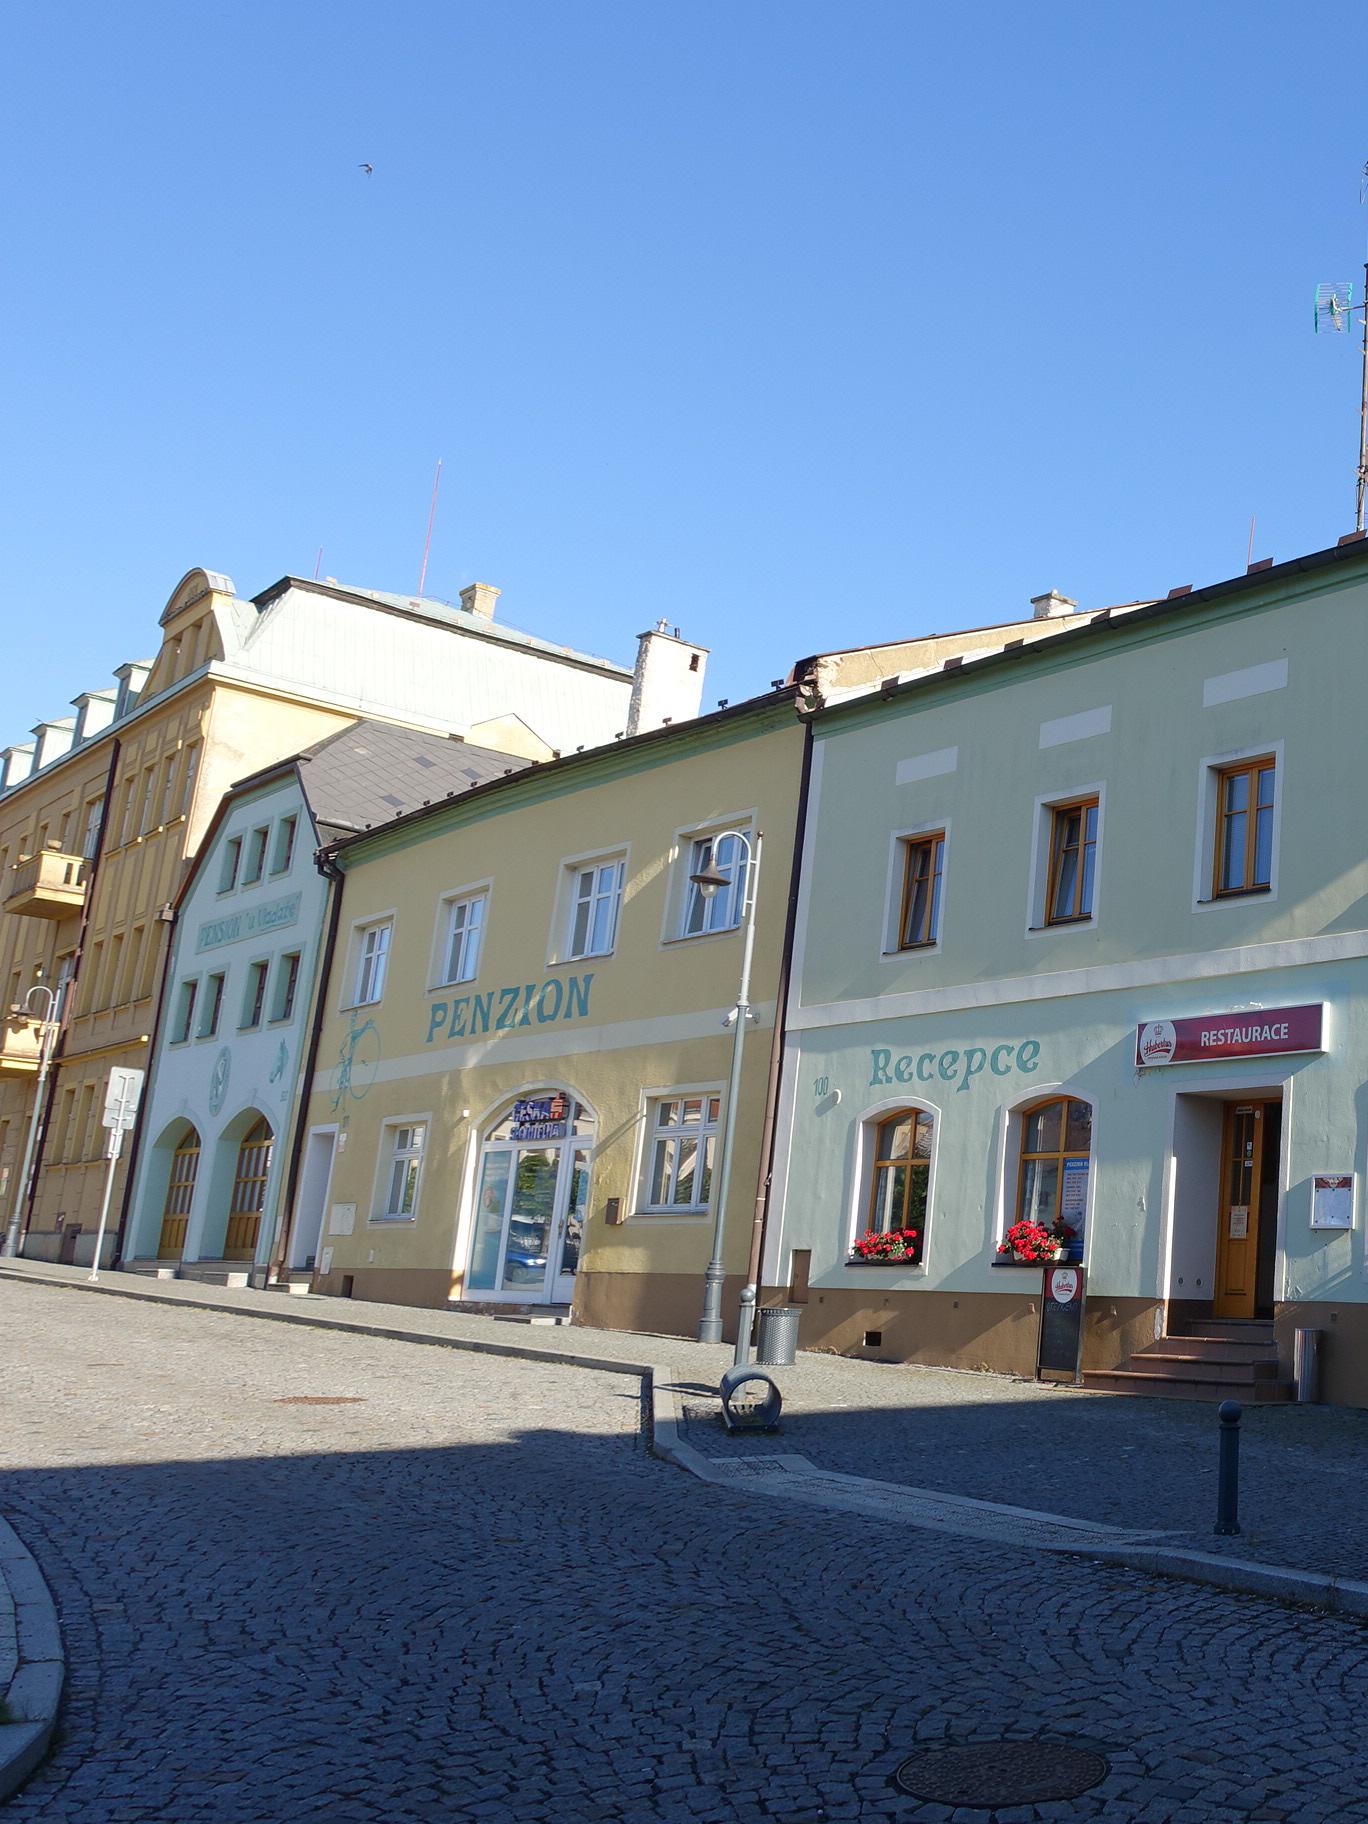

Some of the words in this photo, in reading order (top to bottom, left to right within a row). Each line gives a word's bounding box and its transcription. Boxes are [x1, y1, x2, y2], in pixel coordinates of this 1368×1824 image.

[425, 973, 595, 1043] PENZION
[1201, 1023, 1289, 1047] RESTAURACE
[868, 1040, 1041, 1093] Recepce
[813, 1076, 829, 1096] 100
